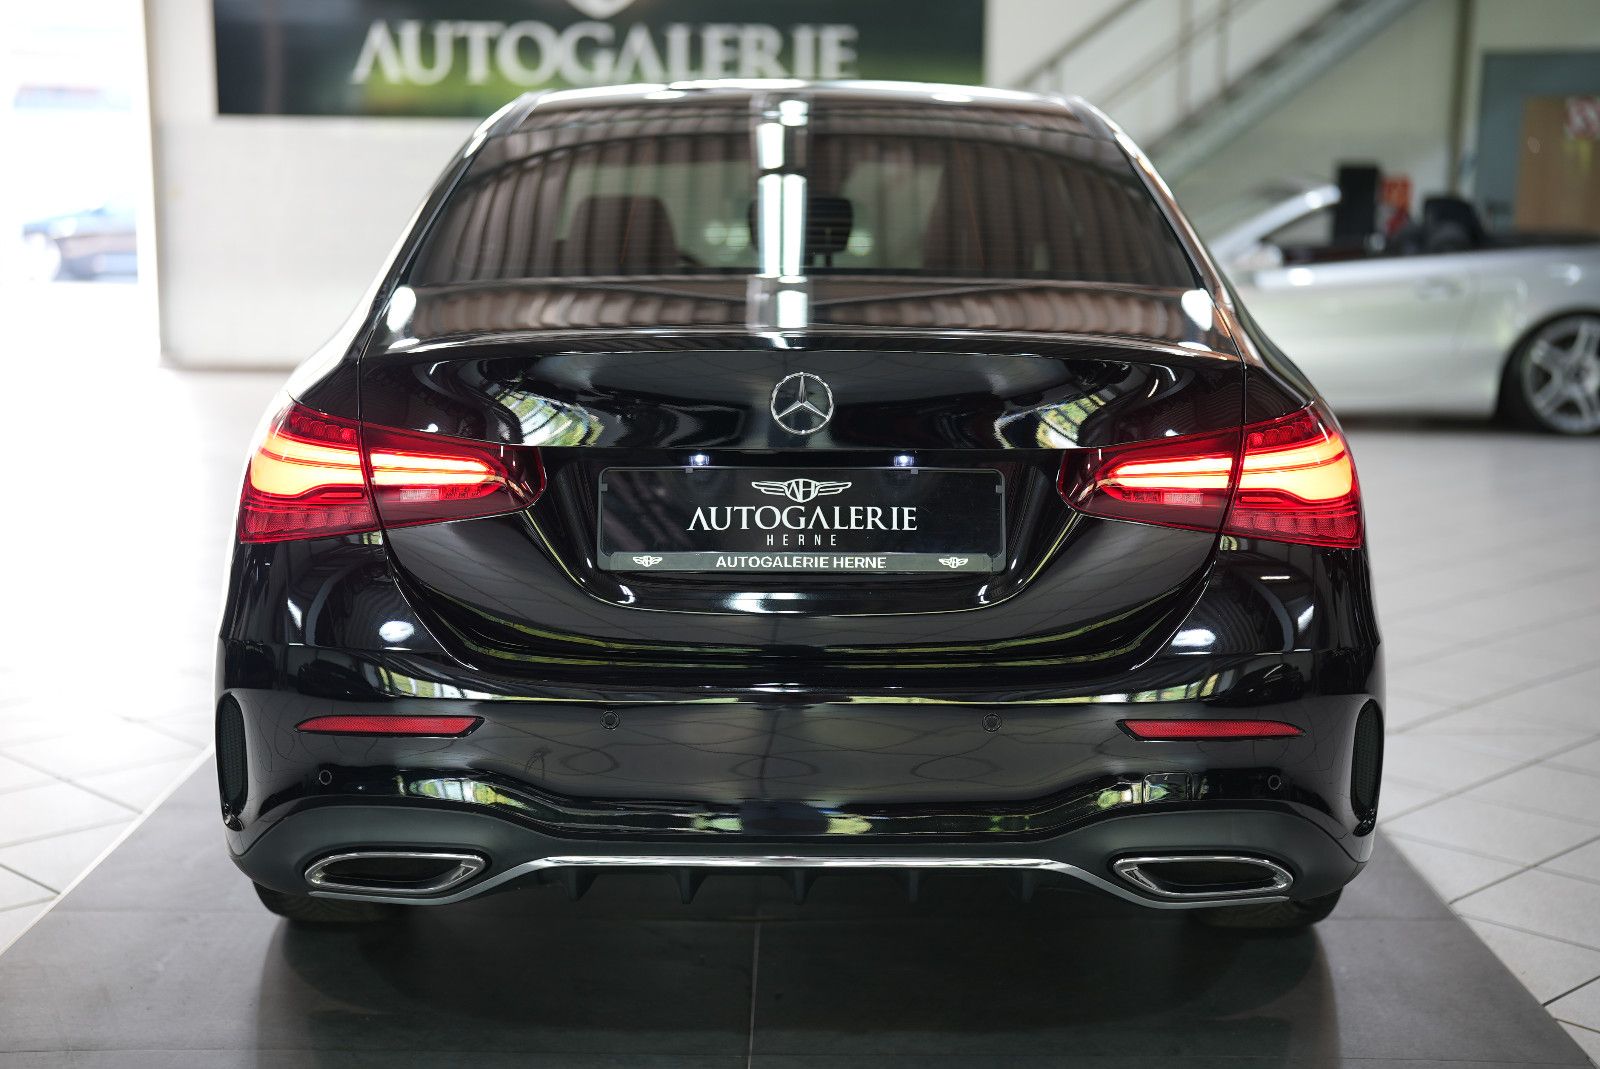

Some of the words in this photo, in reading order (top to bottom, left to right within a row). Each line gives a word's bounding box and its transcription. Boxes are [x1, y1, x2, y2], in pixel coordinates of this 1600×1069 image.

[351, 21, 859, 84] AUTOGALERIE
[687, 505, 917, 531] AUTOGALERIE
[766, 534, 837, 546] HERNE
[716, 556, 830, 569] AUTOGALERIE
[833, 556, 887, 569] HERNE
